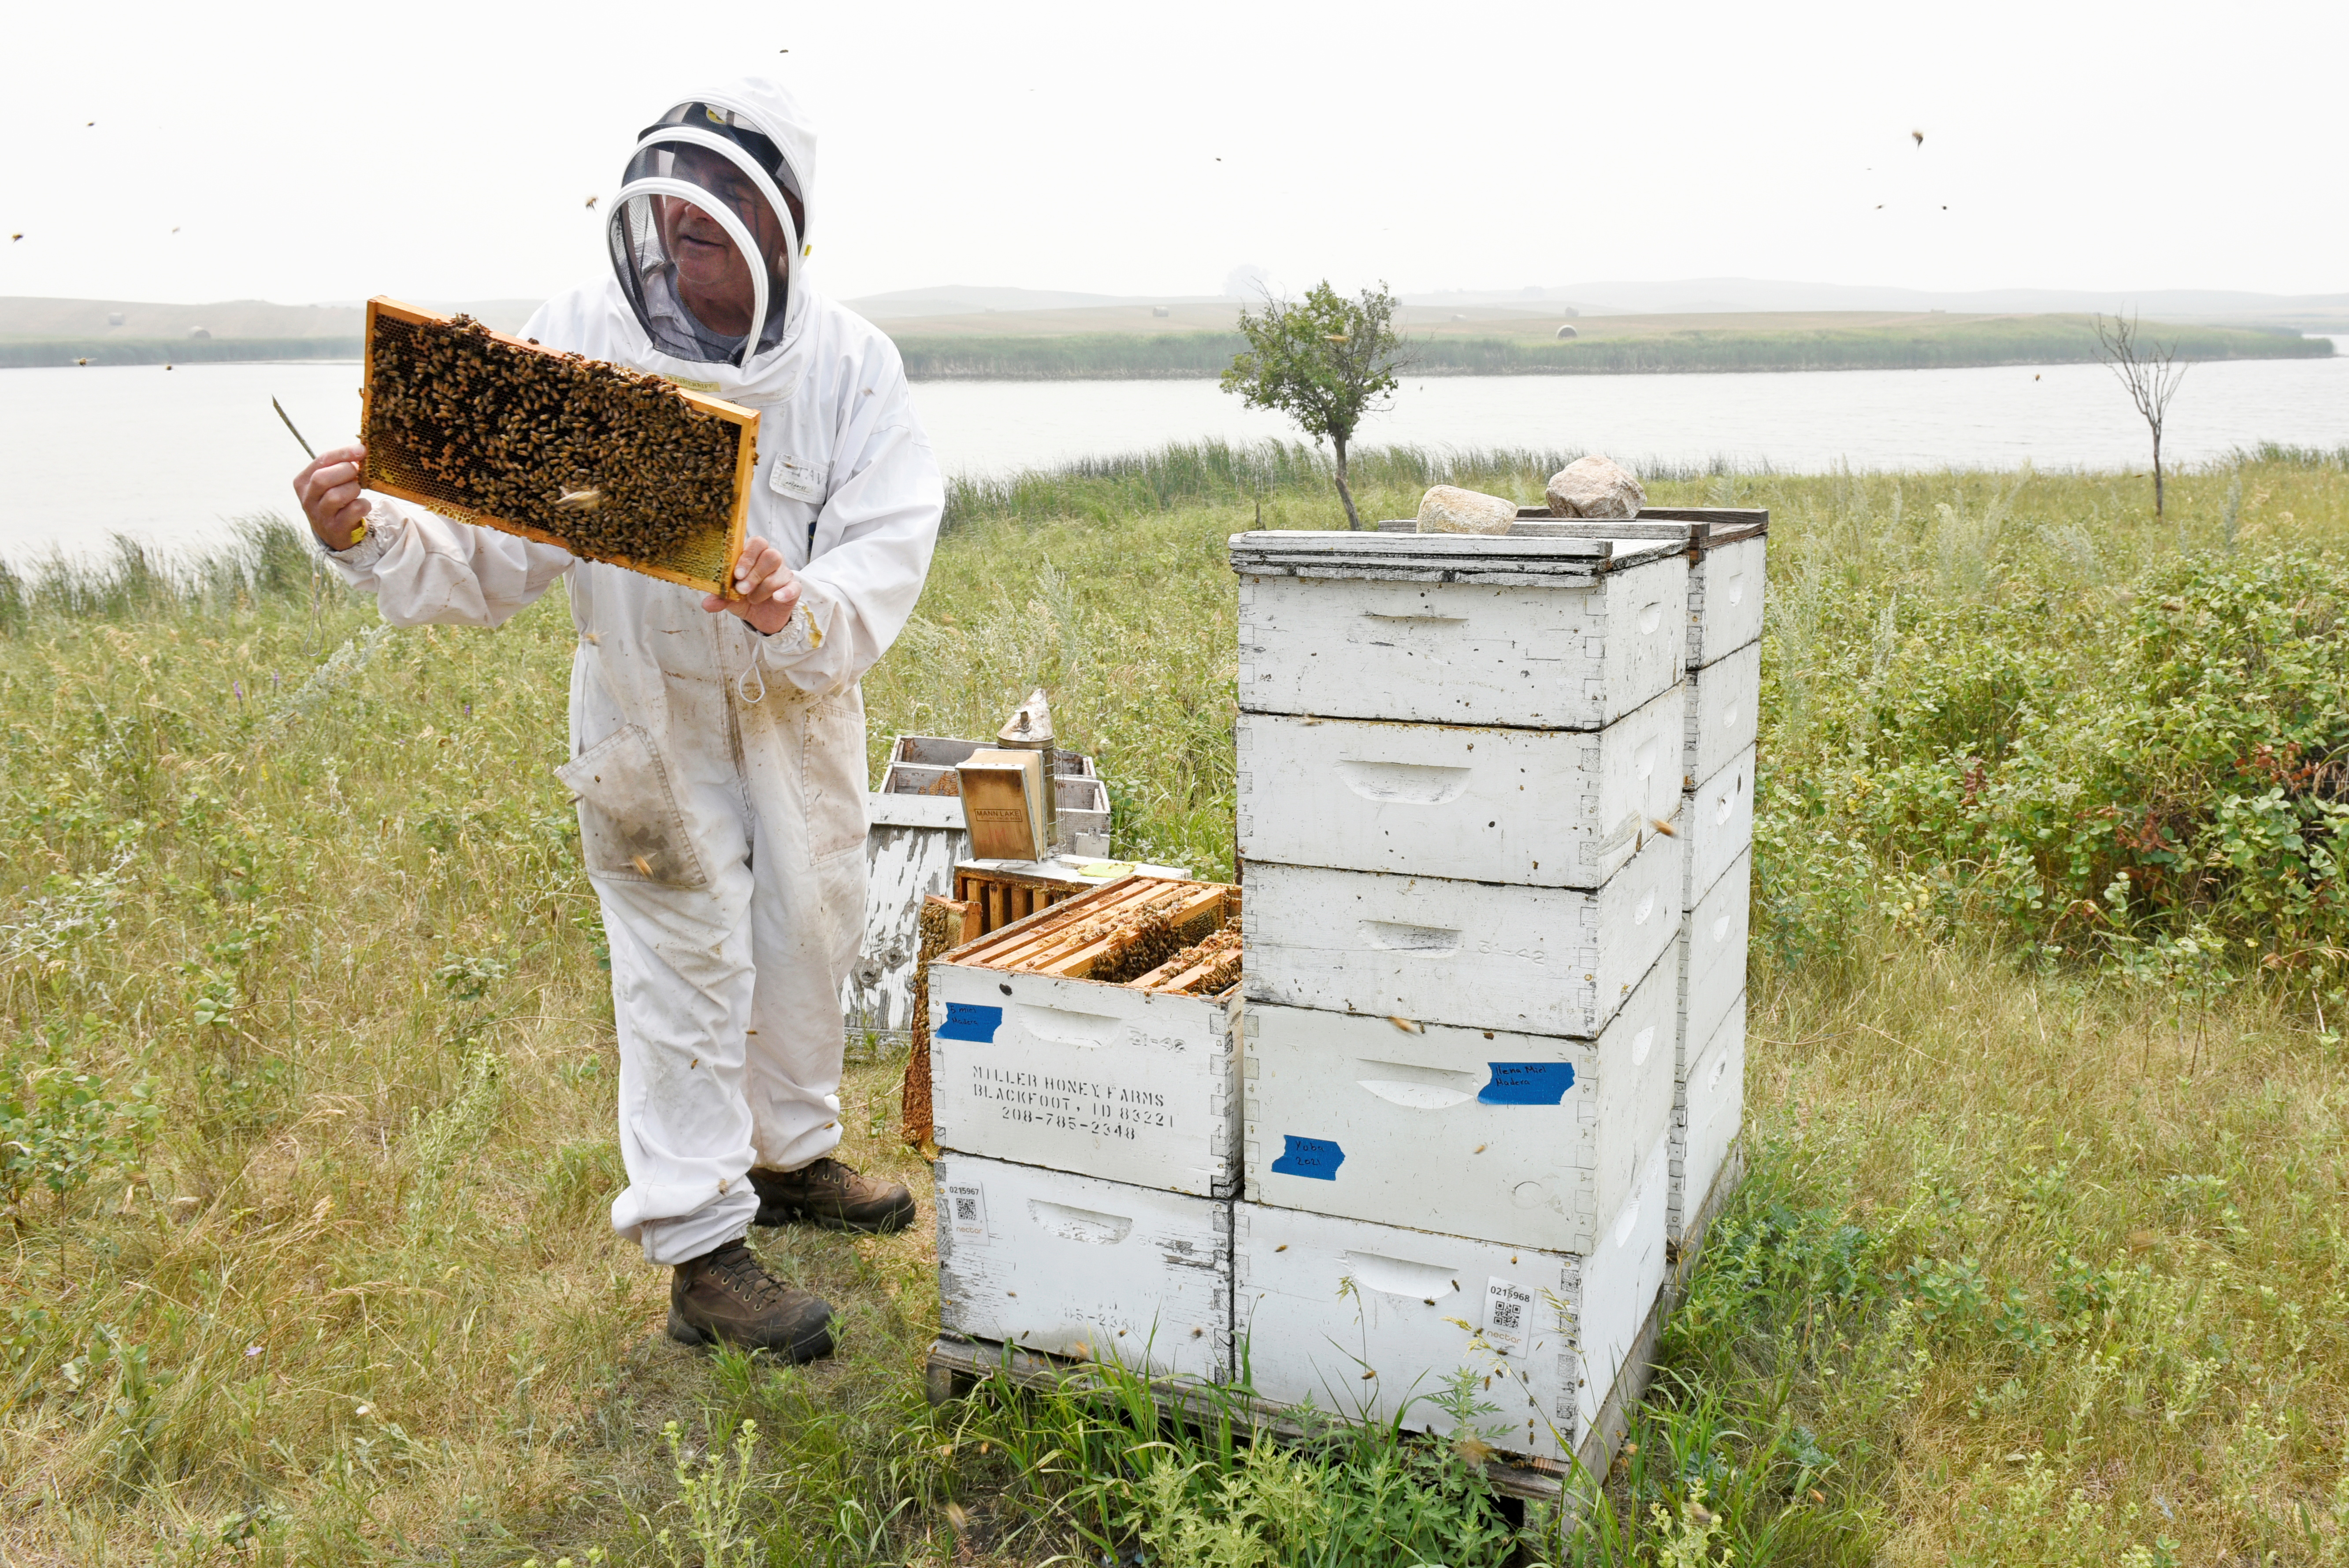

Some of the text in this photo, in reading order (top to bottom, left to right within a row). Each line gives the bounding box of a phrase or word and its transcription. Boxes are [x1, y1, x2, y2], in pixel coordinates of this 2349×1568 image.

[973, 1065, 1164, 1107] MILLER HONEY FARMS
[1495, 1078, 1531, 1087] Madera
[1093, 1101, 1111, 1119] ID
[1120, 1105, 1173, 1128] 83221
[1002, 1106, 1136, 1140] 208-785-2348
[1295, 1141, 1325, 1152] Yuba
[1295, 1156, 1321, 1166] 2021
[949, 1186, 979, 1195] 0215967
[1490, 1286, 1530, 1303] 0215968
[1487, 1330, 1522, 1344] nectar
